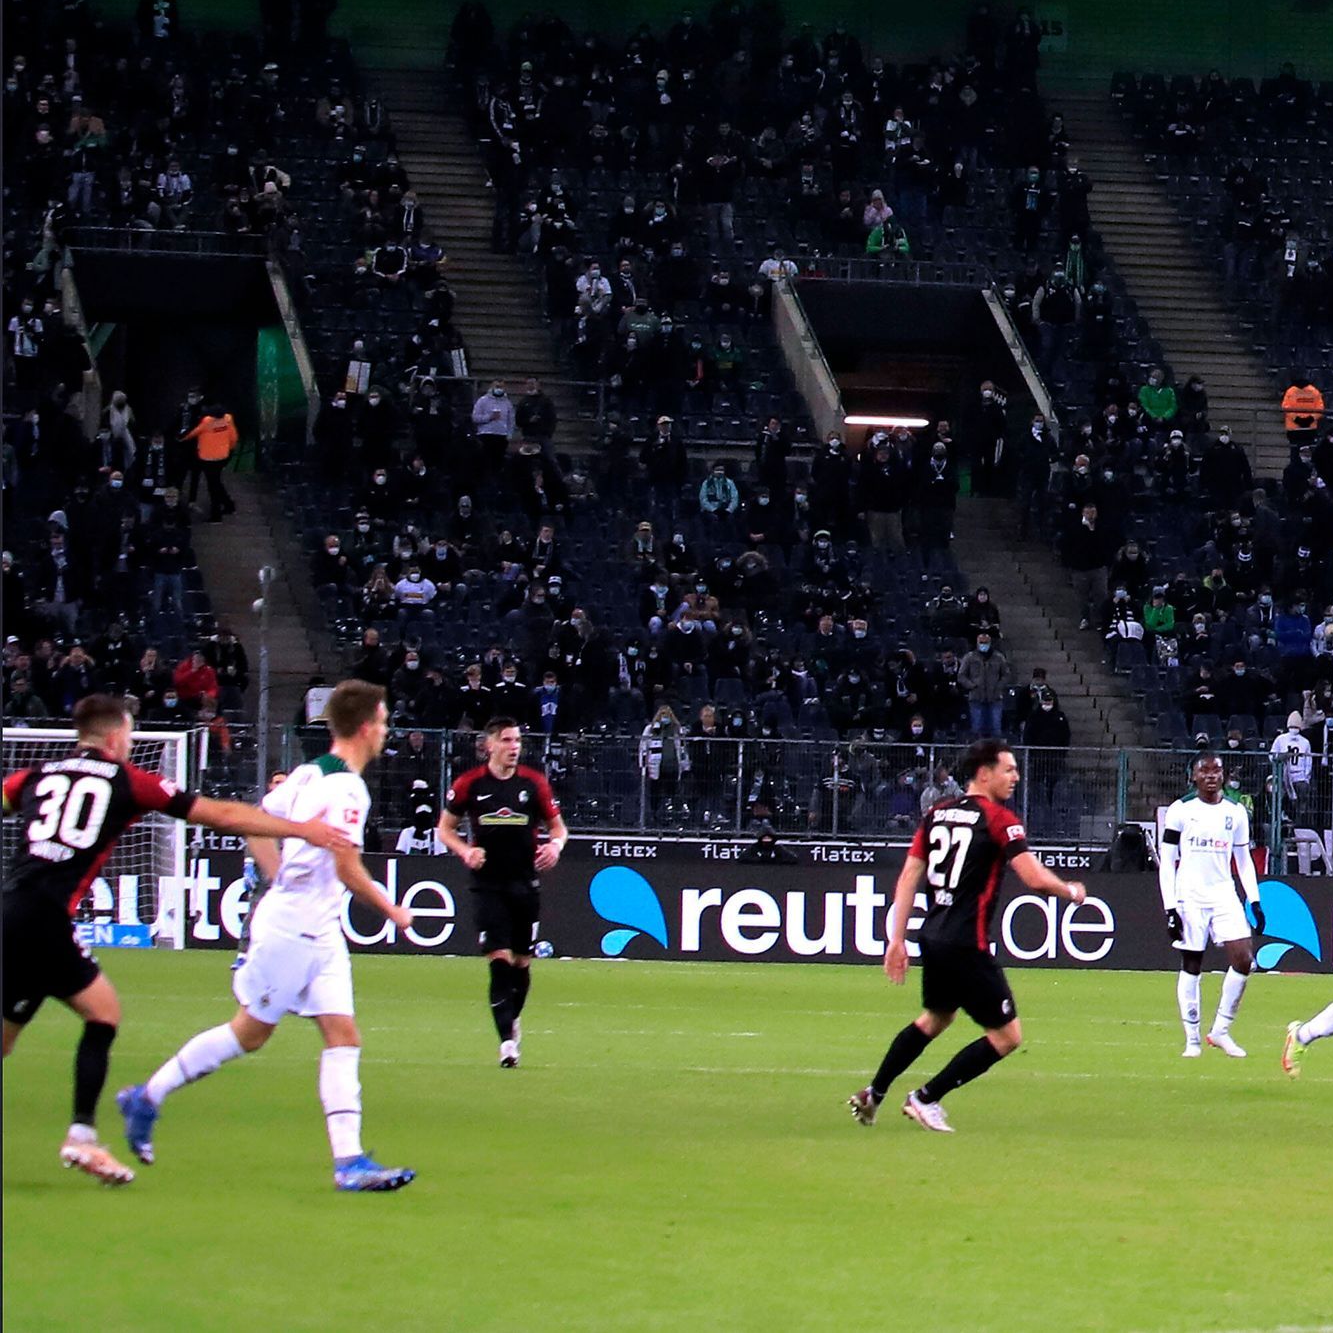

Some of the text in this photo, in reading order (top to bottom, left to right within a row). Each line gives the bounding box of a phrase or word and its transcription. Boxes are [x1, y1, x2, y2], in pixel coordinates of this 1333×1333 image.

[28, 774, 113, 849] 30
[592, 841, 657, 858] flatex
[701, 844, 747, 860] flat
[810, 846, 875, 863] flatex
[927, 825, 973, 889] 27
